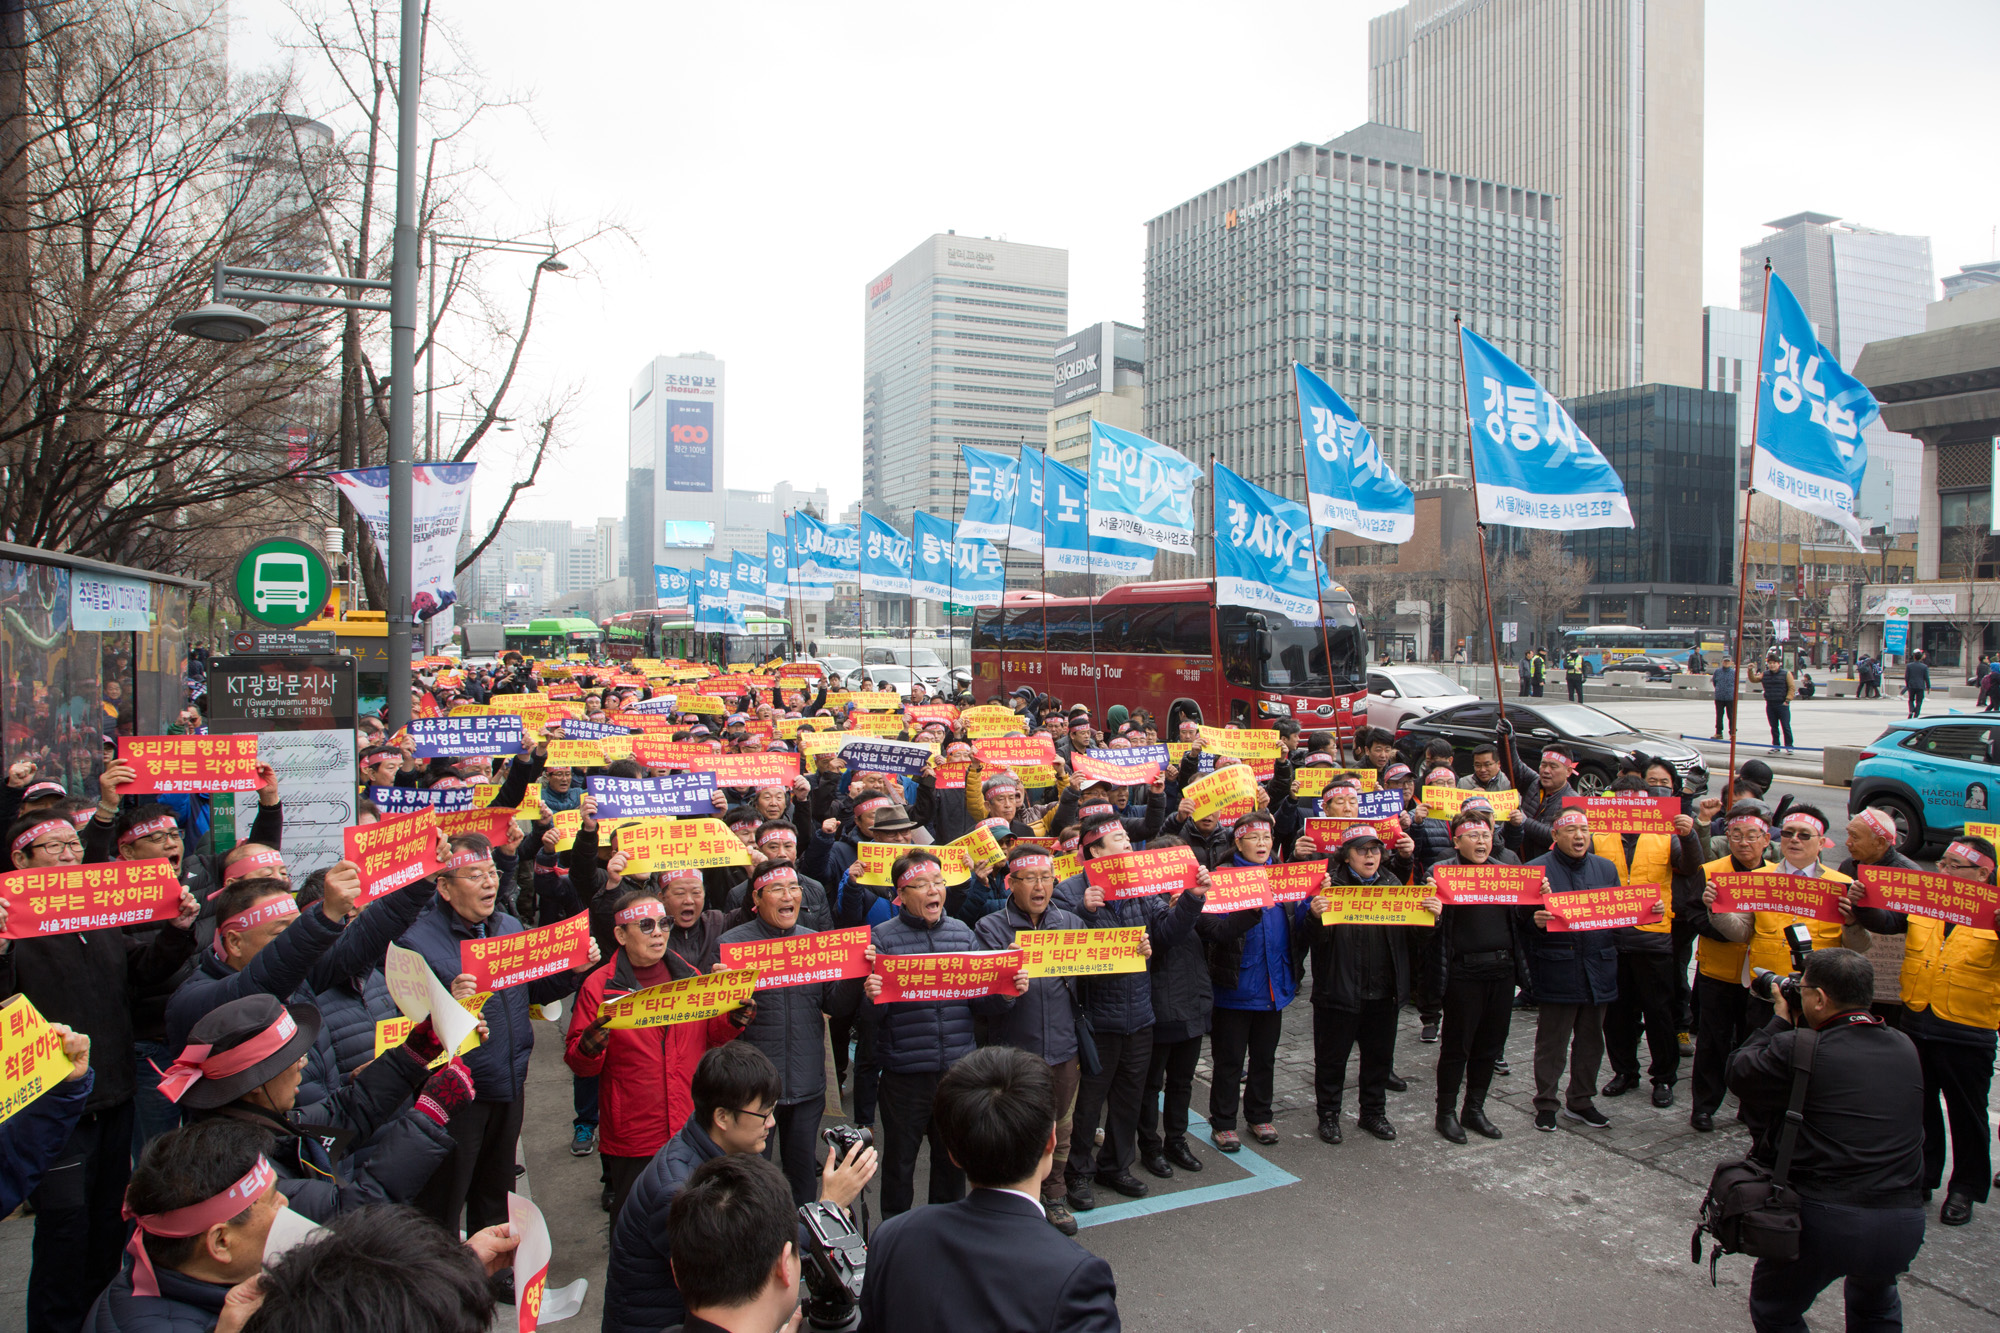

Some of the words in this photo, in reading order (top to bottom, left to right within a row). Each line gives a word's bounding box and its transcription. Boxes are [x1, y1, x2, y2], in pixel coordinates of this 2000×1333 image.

[665, 374, 716, 387] 조선일보
[666, 386, 714, 395] chosun.com
[1484, 377, 1602, 452] 강동지
[671, 424, 708, 444] 100
[689, 446, 706, 454] 100년
[1495, 495, 1613, 519] 서울개인택시운송사업조합
[258, 634, 296, 643] 금연구역
[1061, 662, 1078, 676] Hwa
[1104, 664, 1122, 679] Tour
[227, 674, 337, 696] KT광화문지사
[247, 698, 307, 707] (Gwanghwamun
[252, 708, 274, 717] 정류소
[412, 718, 472, 732] 공유경제로
[476, 718, 521, 729] 꼼수쓰는
[414, 732, 461, 745] 택시영업
[495, 731, 522, 743] 퇴출!
[636, 741, 680, 752] 영리카풀행위
[128, 739, 232, 756] 영리카풀행위
[146, 759, 198, 774] 정부는
[693, 755, 755, 767] 영리카풀행위
[759, 755, 797, 766] 방조하는
[742, 764, 785, 776] 각성하라!
[593, 777, 656, 791] 공유경제로
[661, 774, 712, 789] 꼼수쓰는
[376, 788, 441, 804] 공유경제로
[1921, 789, 1962, 798] HAECHI
[214, 807, 234, 815] 7018
[620, 804, 692, 815] 서울개인택시운송사업조합
[1928, 798, 1962, 807] SEOUL
[354, 822, 412, 853] 영리카풀행위
[622, 827, 665, 844] 렌터카
[670, 824, 697, 839] 불법
[364, 853, 393, 876] 정부는
[395, 835, 428, 864] 각성하라!
[862, 846, 898, 858] 렌터카
[653, 856, 731, 870] 서울개인택시운송사업조합
[1090, 852, 1156, 875] 영리카풀행위
[1287, 862, 1326, 876] 방조하는
[4, 867, 120, 895] 영리카풀행위
[1107, 868, 1140, 886] 정부는
[1142, 863, 1188, 880] 각성하라!
[1437, 866, 1495, 878] 영리카풀행위
[1499, 867, 1541, 879] 방조하는
[1114, 879, 1184, 897] 서울개인택시운송사업조합
[1219, 882, 1266, 897] 각성하라!
[1449, 880, 1476, 891] 정부는
[1479, 880, 1524, 891] 각성하라!
[1715, 875, 1790, 889] 영리카풀행위
[1795, 878, 1842, 896] 방조하는
[1864, 868, 1948, 891] 영리카풀행위
[1953, 880, 1999, 903] 방조하는
[29, 894, 85, 915] 정부는
[92, 884, 164, 907] 각성하라!
[1453, 894, 1518, 903] 서울개인택시운송사업조합
[1548, 891, 1611, 908] 영리카풀행위
[1613, 887, 1657, 902] 방조하는
[1730, 887, 1767, 899] 정부는
[1771, 889, 1824, 906] 각성하라!
[1880, 885, 1921, 900] 정부는
[1926, 892, 1980, 914] 각성하라!
[1344, 914, 1406, 922] 서울개인택시운송사업조합
[1562, 906, 1592, 919] 정부는
[1596, 902, 1643, 916] 각성하라!
[1736, 902, 1816, 917] 서울개인택시운송사업조합
[1886, 901, 1972, 926] 서울개인택시운송사업조합
[38, 908, 154, 933] 서울개인택시운송사업조합
[1568, 916, 1638, 930] 서울개인택시운송사업조합
[470, 927, 550, 960] 영리카풀행위
[554, 915, 589, 938] 방조하는
[729, 938, 811, 962] 영리카풀행위
[816, 930, 868, 950] 방조하는
[1020, 933, 1059, 948] 렌터카
[1063, 931, 1088, 945] 불법
[1094, 929, 1142, 943] 택시영업
[487, 952, 526, 975] 정부는
[528, 938, 578, 966] 각성하라!
[745, 956, 785, 972] 정부는
[790, 950, 848, 967] 각성하라!
[882, 956, 964, 973] 영리카풀행위
[970, 954, 1019, 970] 방조하는
[1044, 962, 1114, 974] 서울개인택시운송사업조합
[695, 970, 755, 989] 택시영업
[896, 972, 936, 986] 정부는
[942, 972, 998, 986] 각성하라!
[901, 986, 989, 1000] 서울개인택시운송사업조합
[602, 1000, 634, 1018] 불법
[686, 988, 752, 1007] 척결하라!
[634, 1008, 719, 1026] 서울개인택시운송사업조합
